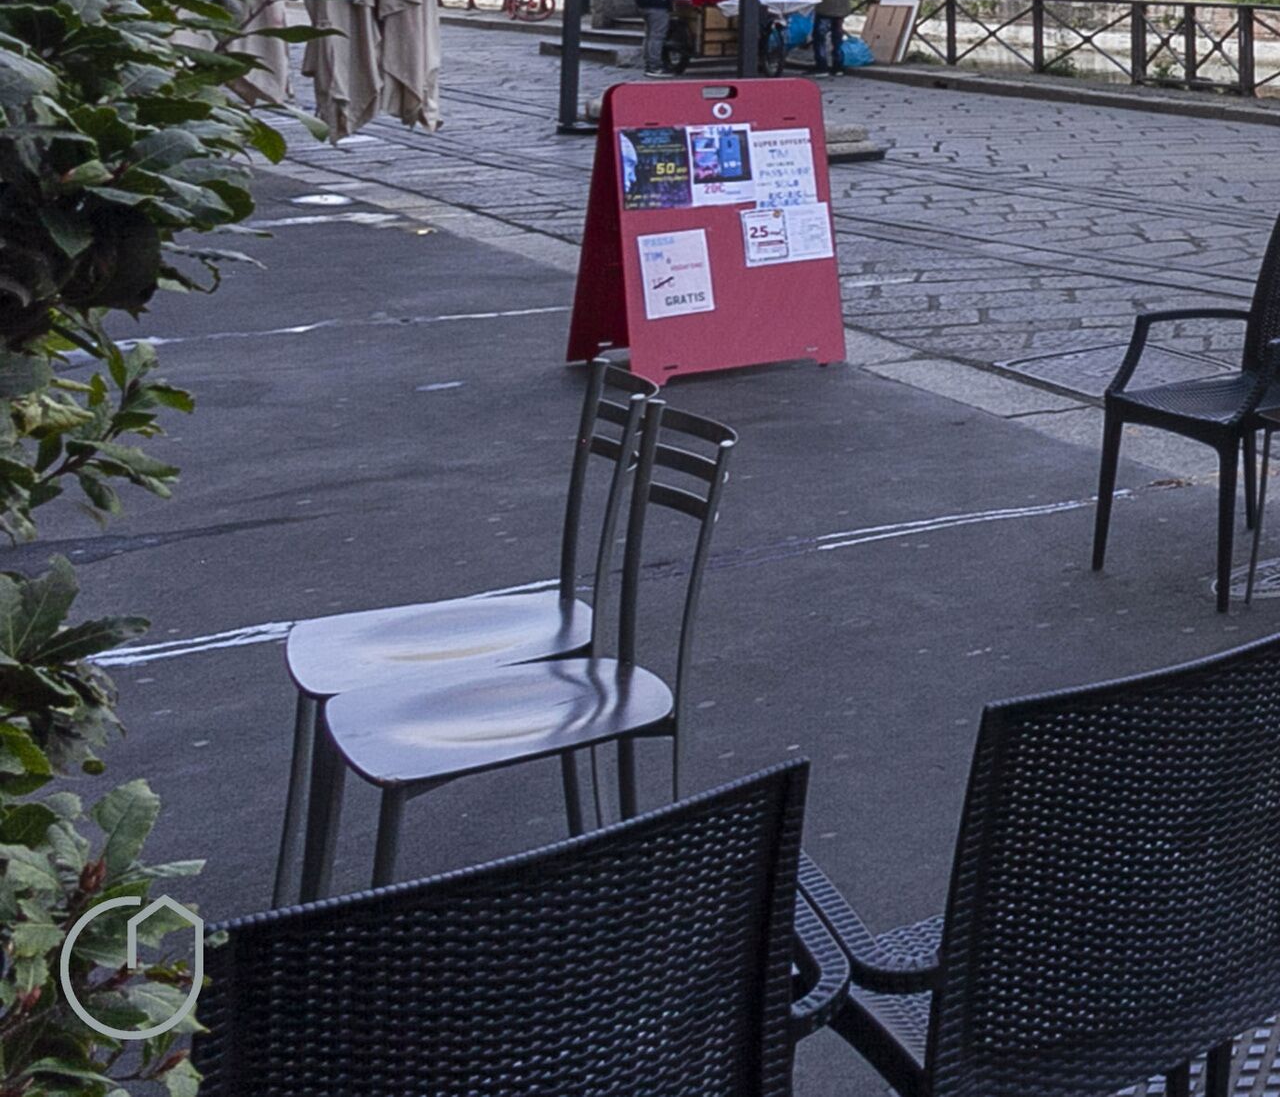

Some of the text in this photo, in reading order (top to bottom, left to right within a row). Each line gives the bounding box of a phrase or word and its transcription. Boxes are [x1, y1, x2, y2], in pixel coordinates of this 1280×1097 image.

[656, 162, 676, 175] 50
[749, 225, 769, 239] 25
[664, 291, 706, 307] GRATIS
